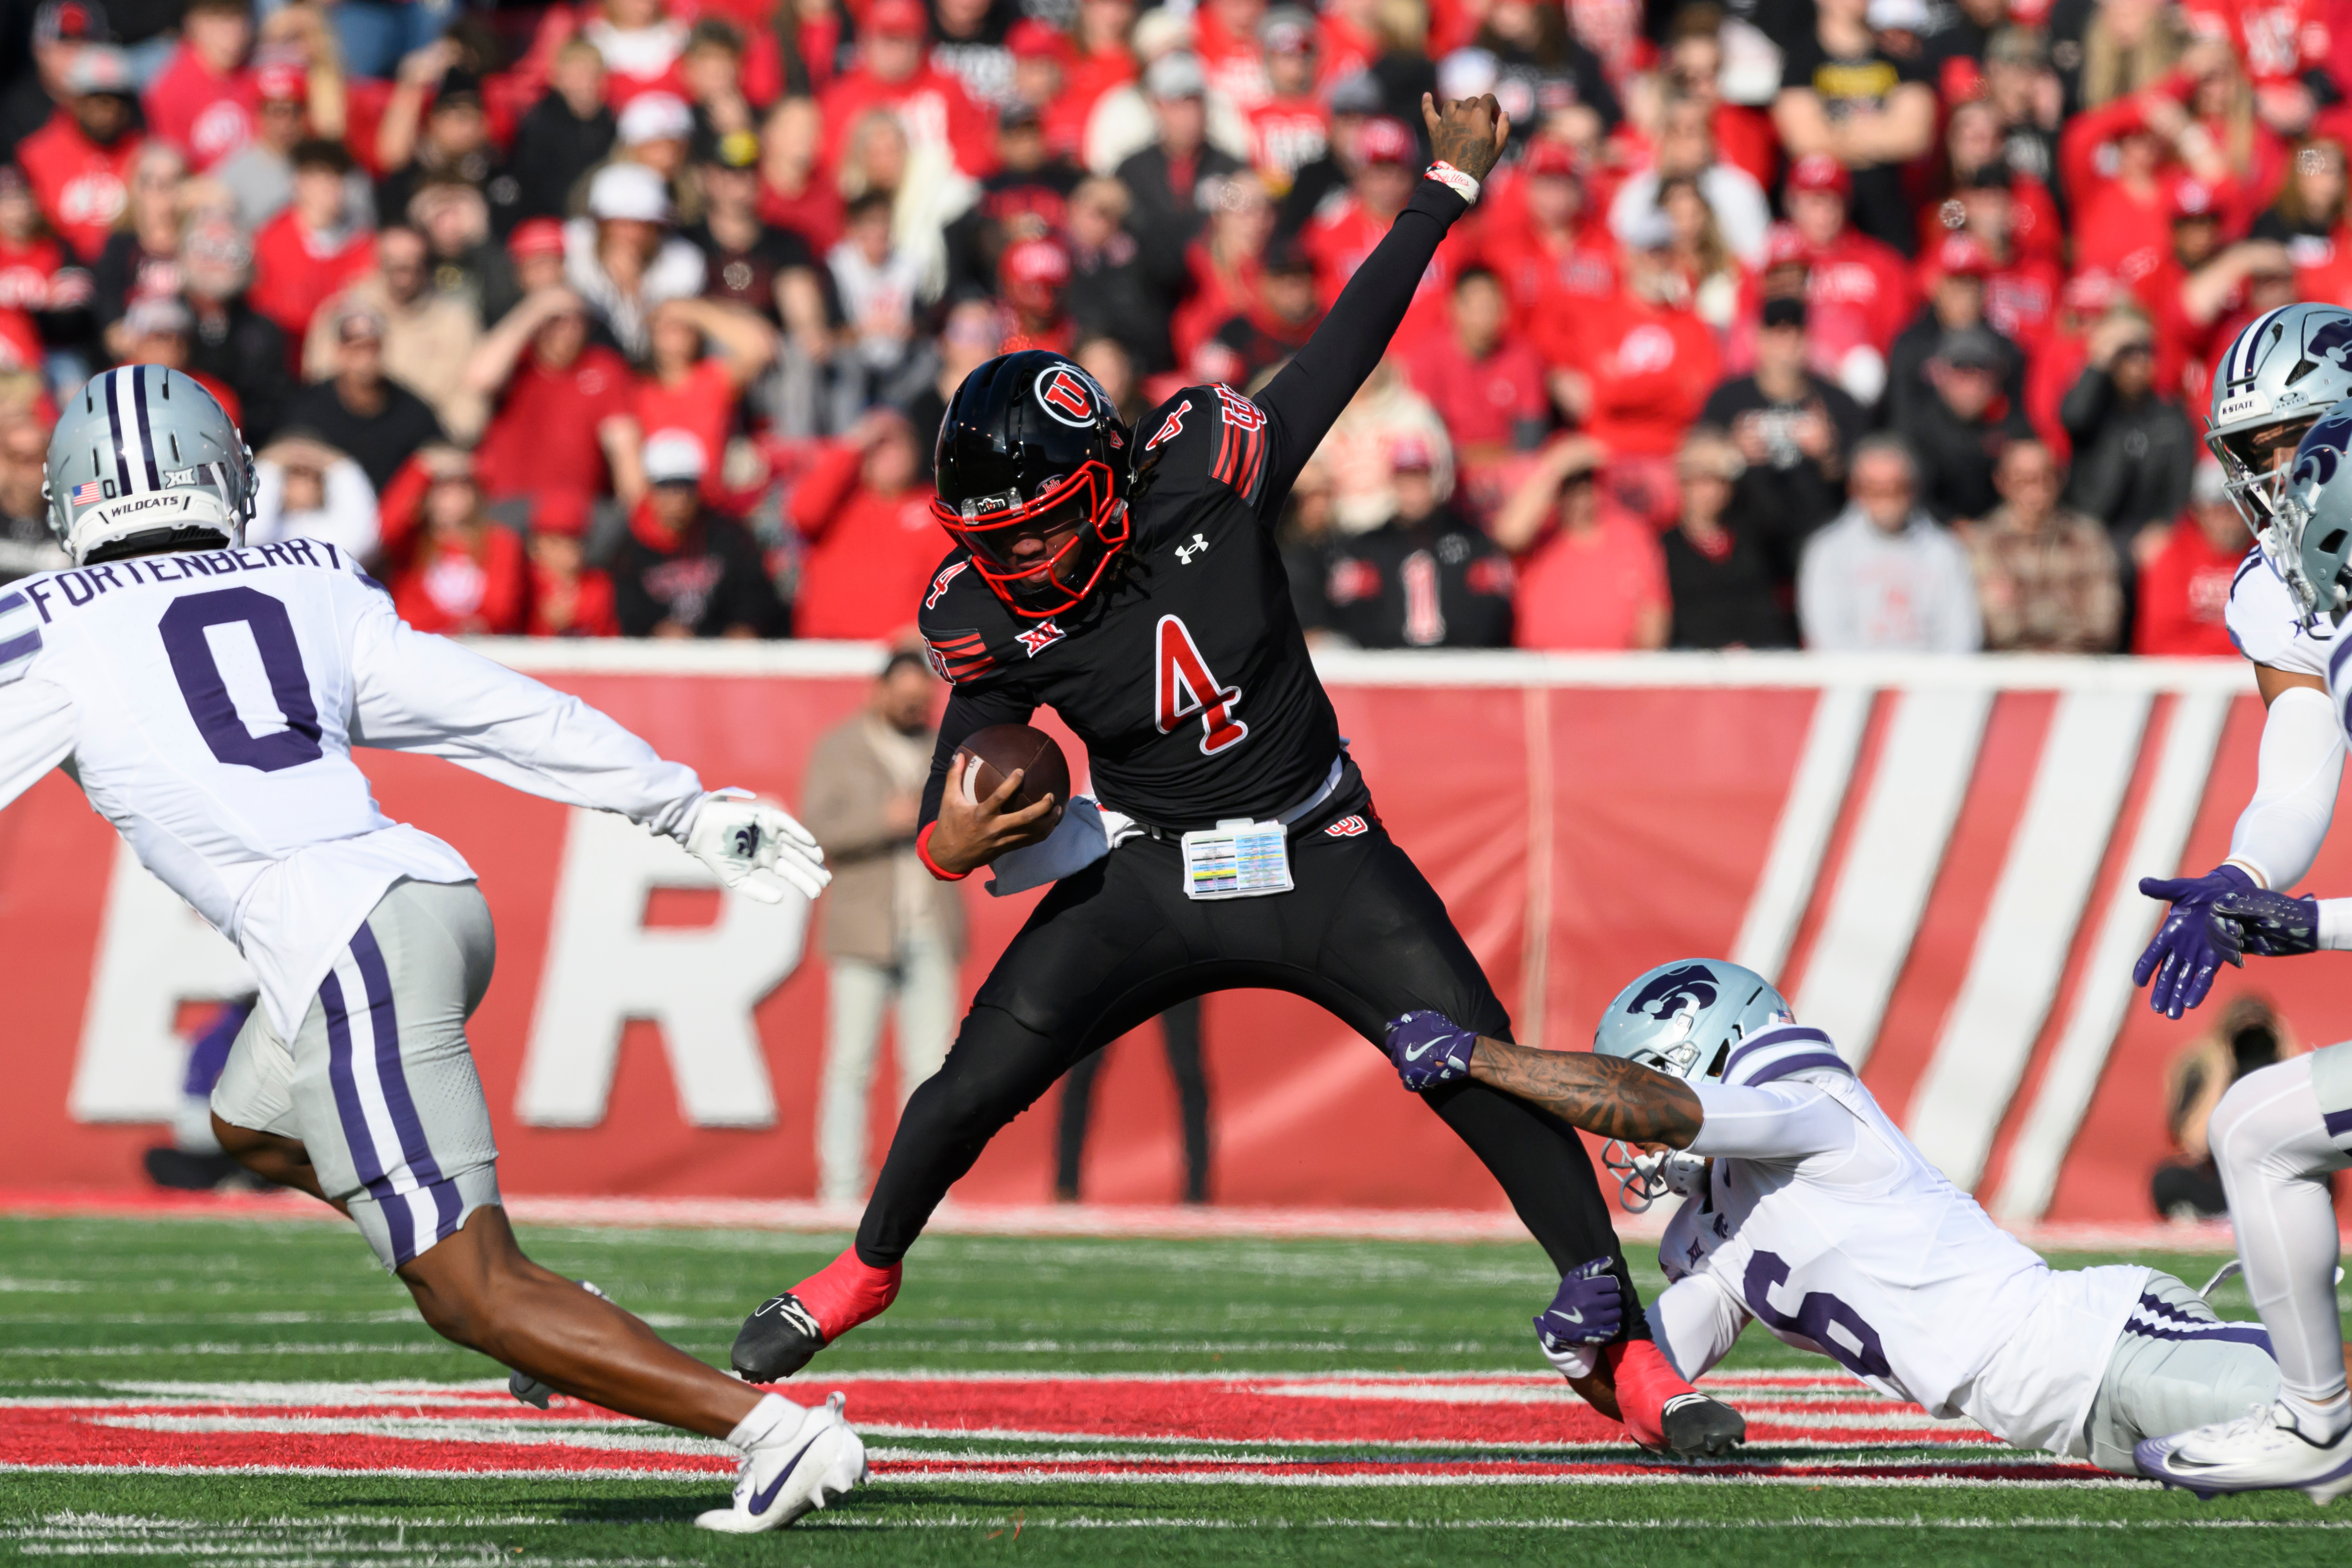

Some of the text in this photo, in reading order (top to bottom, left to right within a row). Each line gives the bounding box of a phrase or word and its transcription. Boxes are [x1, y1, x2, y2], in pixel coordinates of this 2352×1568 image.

[1145, 399, 1193, 451] 4
[2222, 399, 2254, 415] K-STATE
[102, 479, 116, 499] 0
[111, 496, 178, 517] WILDCATS
[25, 536, 343, 625] FORTENBERRY
[926, 560, 970, 610] 4
[158, 586, 323, 773] 0
[1155, 614, 1248, 756] 4
[1743, 1249, 1891, 1379] 6
